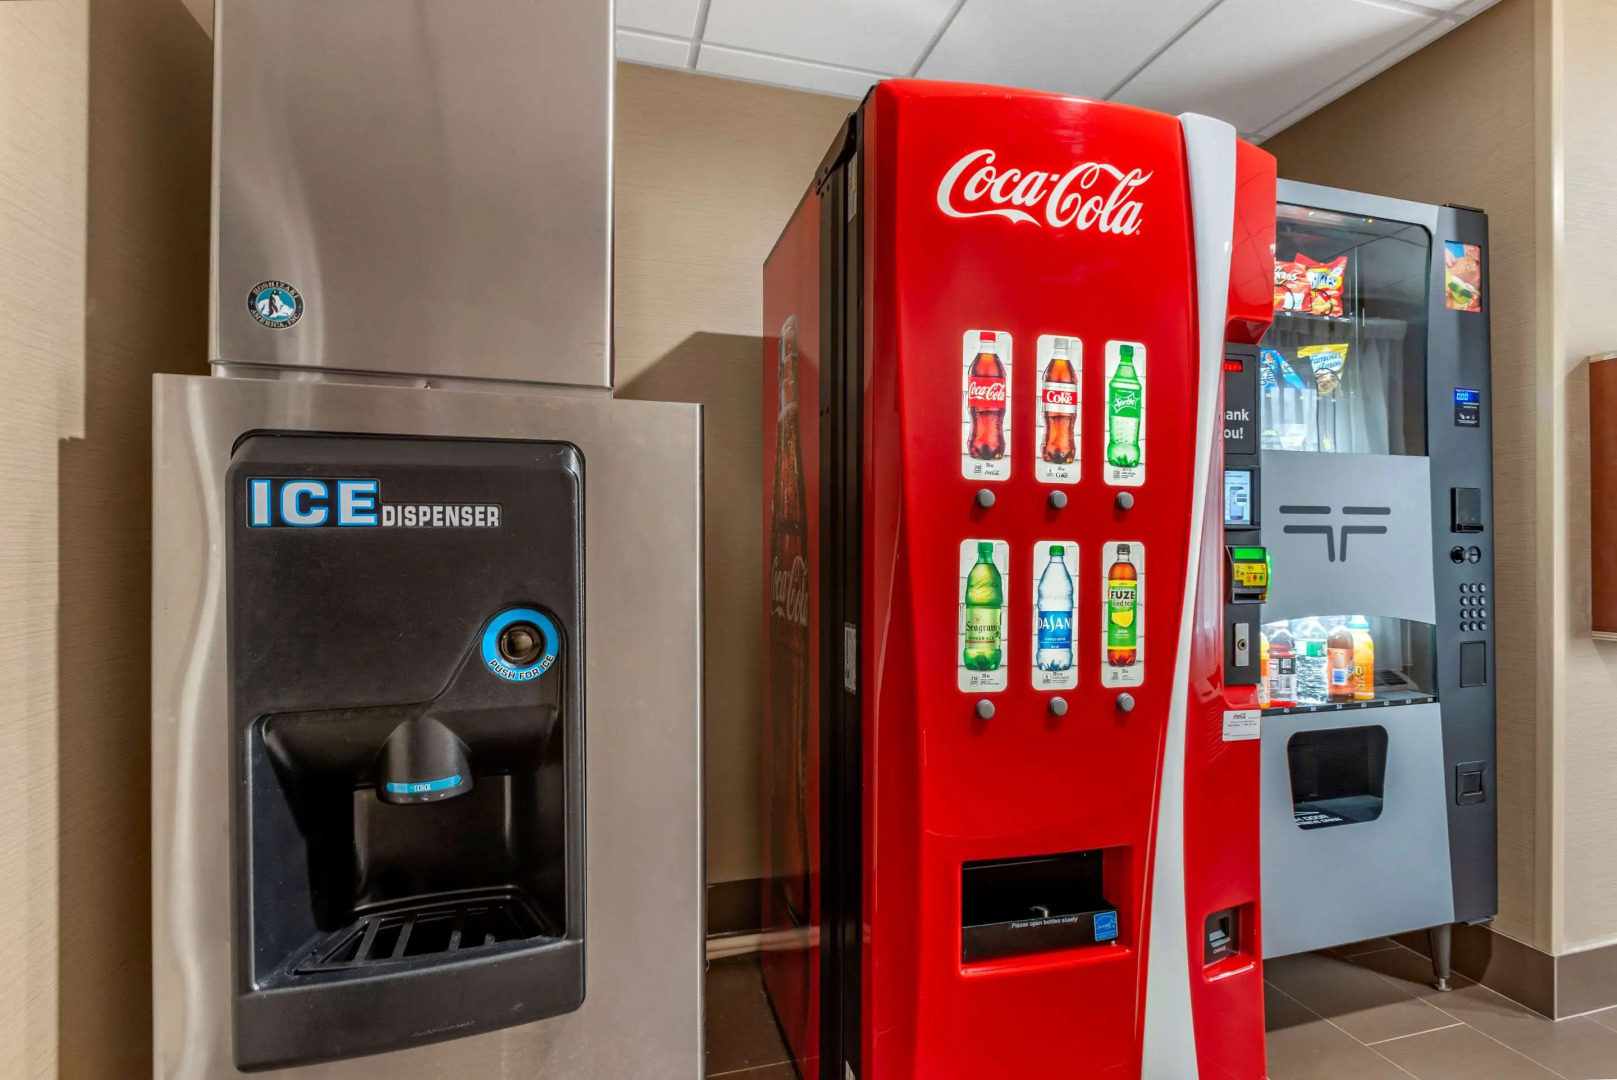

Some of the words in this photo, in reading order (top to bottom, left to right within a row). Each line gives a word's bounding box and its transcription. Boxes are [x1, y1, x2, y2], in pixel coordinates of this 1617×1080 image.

[937, 149, 1154, 235] Coca-Cola
[253, 281, 299, 298] HOSHIZAKI
[968, 381, 1005, 401] Coca-Cola
[1046, 390, 1073, 404] Coke
[1114, 397, 1137, 408] Sprite
[1225, 409, 1249, 421] ank
[1224, 427, 1244, 439] ou!
[251, 479, 378, 527] ICE
[382, 505, 500, 527] DISPENSER
[1110, 590, 1135, 600] FUZE
[966, 621, 1001, 633] Seagram's
[489, 659, 516, 679] PUSH
[519, 668, 540, 680] FOR
[539, 653, 555, 671] ICE
[1061, 916, 1079, 924] slowly
